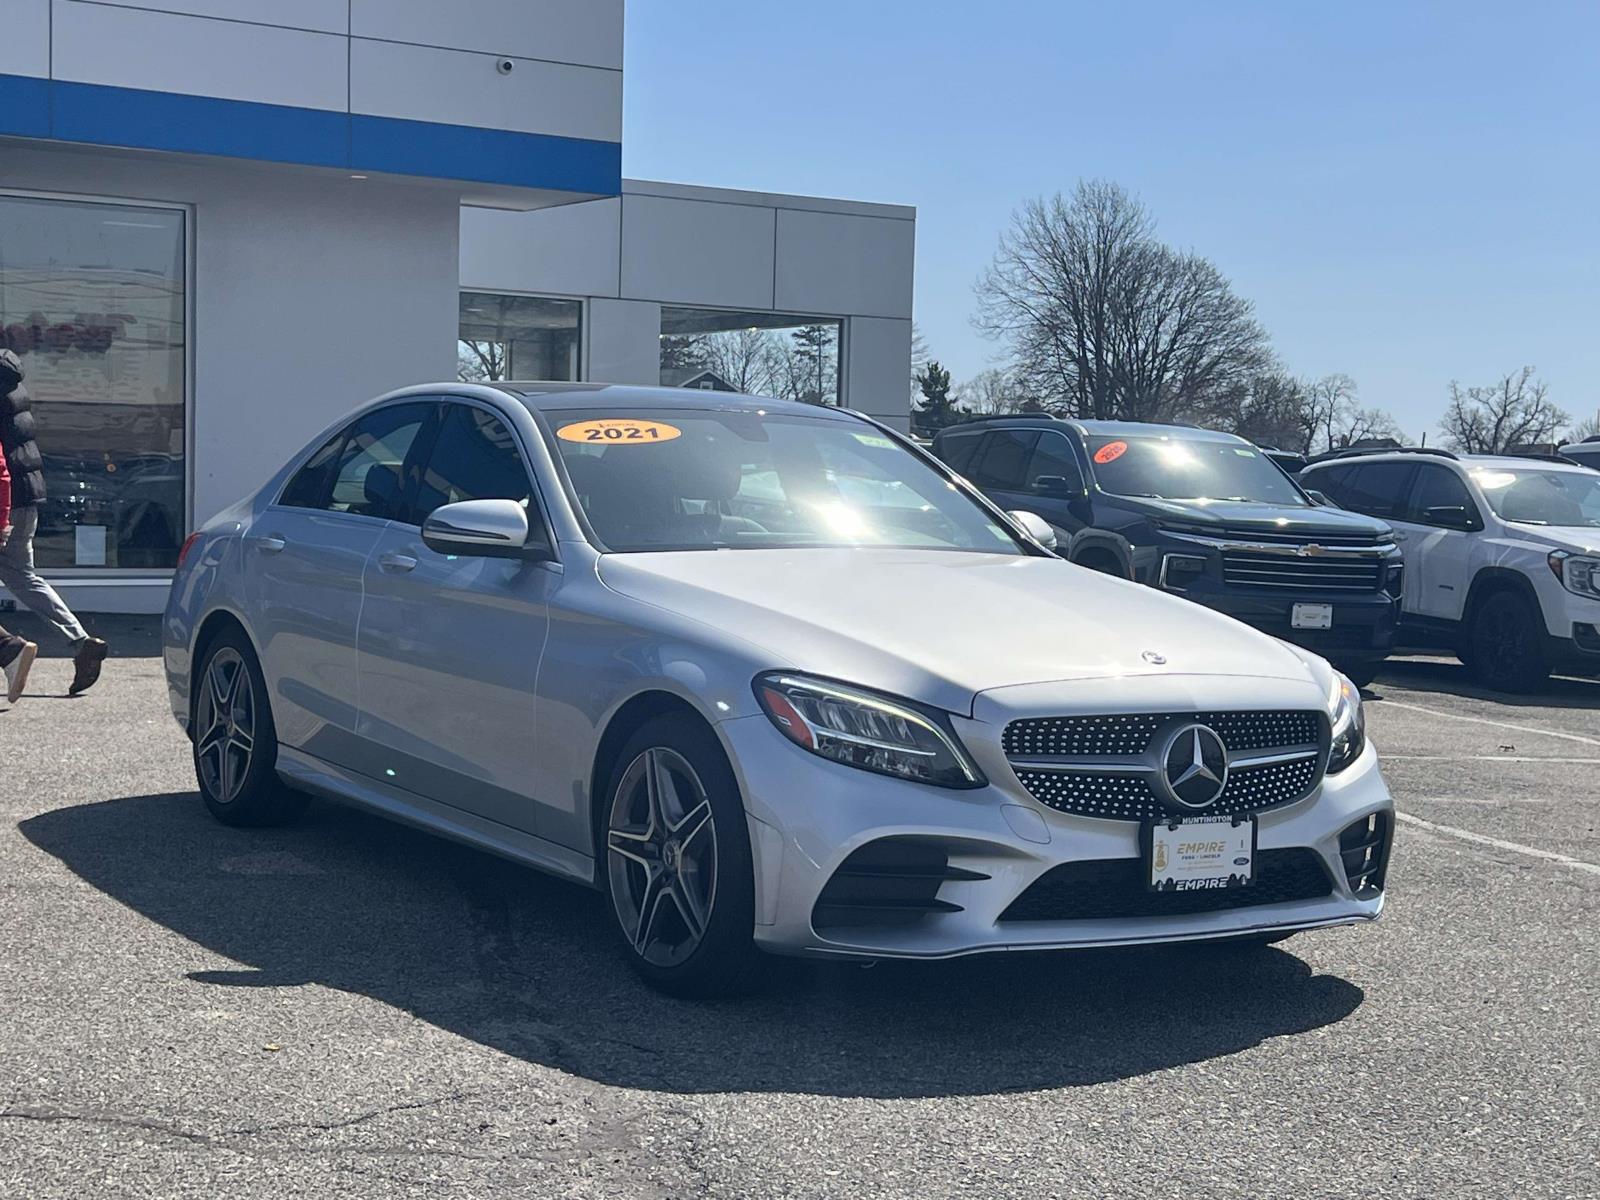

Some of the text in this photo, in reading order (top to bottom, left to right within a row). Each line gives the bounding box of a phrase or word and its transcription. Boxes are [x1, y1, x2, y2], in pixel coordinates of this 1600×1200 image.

[584, 427, 658, 440] 2021
[1182, 815, 1233, 824] HUNTINGTON
[1177, 841, 1227, 854] EMPIRE
[1176, 877, 1229, 891] EMPIRE
